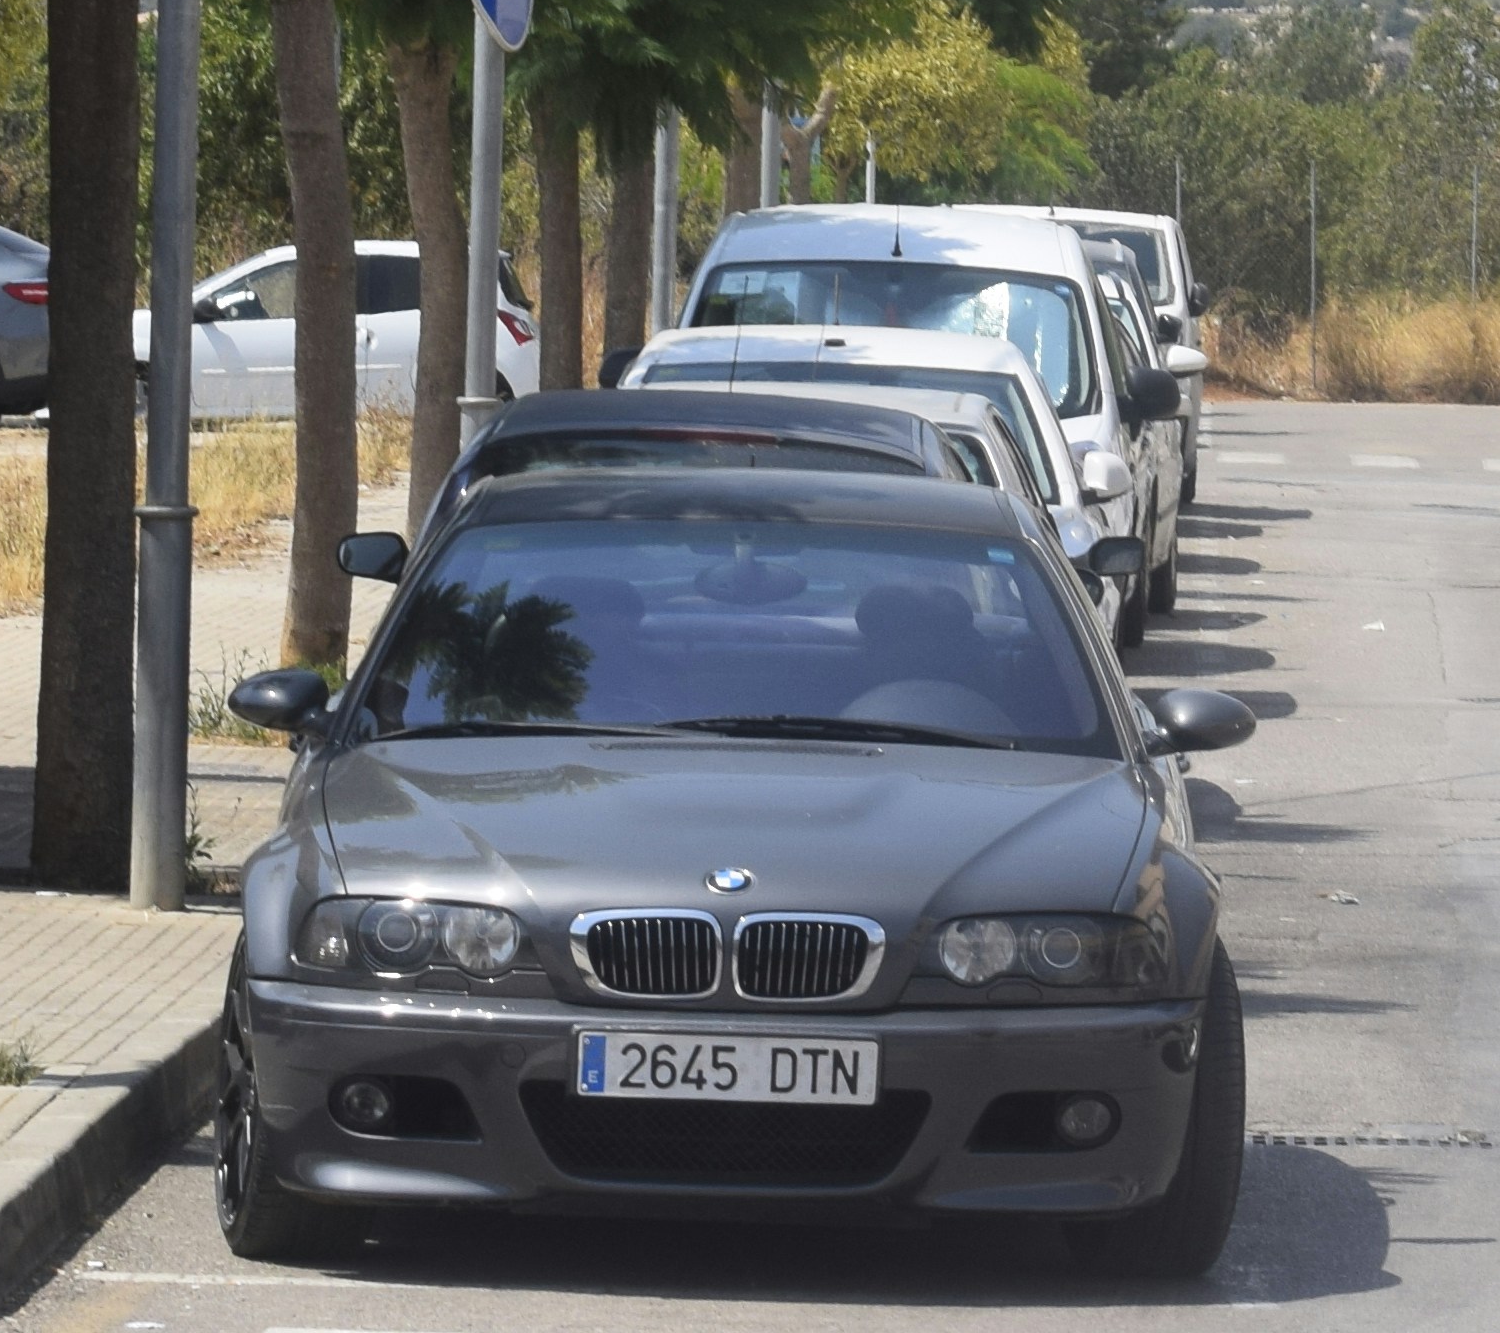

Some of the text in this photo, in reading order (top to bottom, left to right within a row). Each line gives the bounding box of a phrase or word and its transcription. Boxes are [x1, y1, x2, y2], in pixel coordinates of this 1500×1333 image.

[588, 1070, 599, 1083] E
[619, 1043, 860, 1095] 2645 DTN
